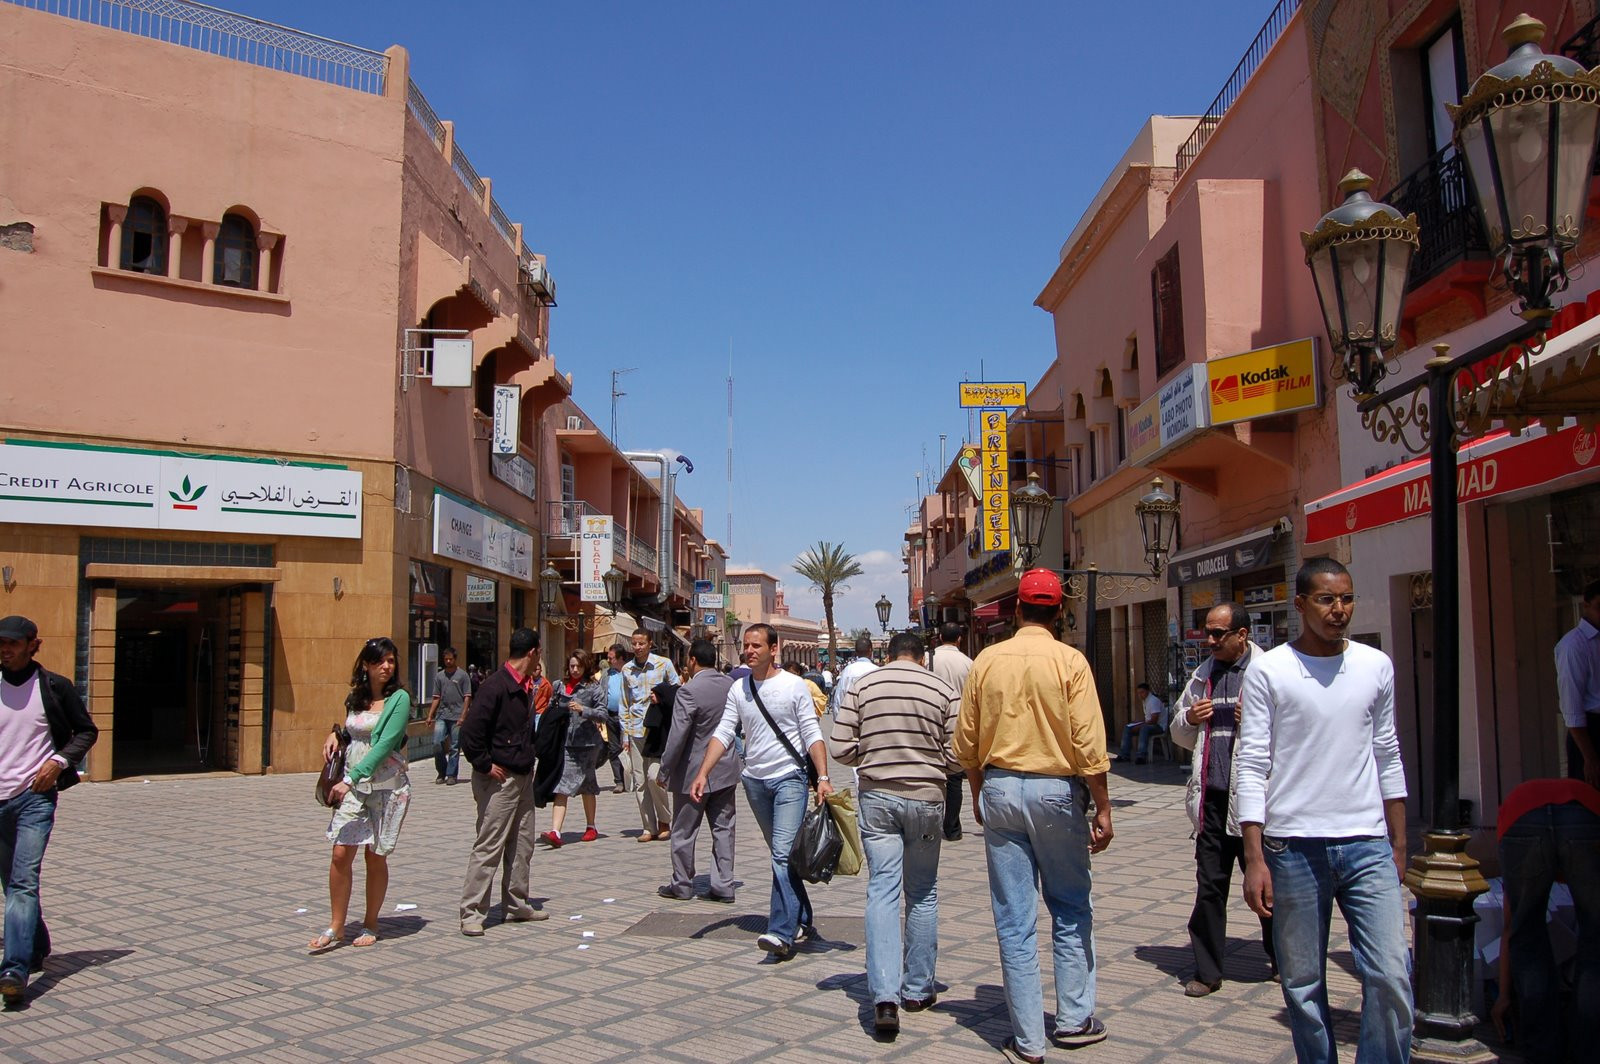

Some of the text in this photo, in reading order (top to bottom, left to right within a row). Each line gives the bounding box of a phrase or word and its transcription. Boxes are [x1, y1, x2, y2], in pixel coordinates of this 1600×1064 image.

[1240, 365, 1311, 393] Kodak FILM
[1162, 394, 1192, 426] LABO PHOTO
[1166, 415, 1189, 440] MONDIAL
[67, 478, 154, 494] AGRICOLE
[987, 413, 1003, 549] PRINCES
[221, 485, 358, 509] القرض الفلاحي
[451, 518, 472, 536] CHANGE
[1197, 555, 1230, 577] DURACELL
